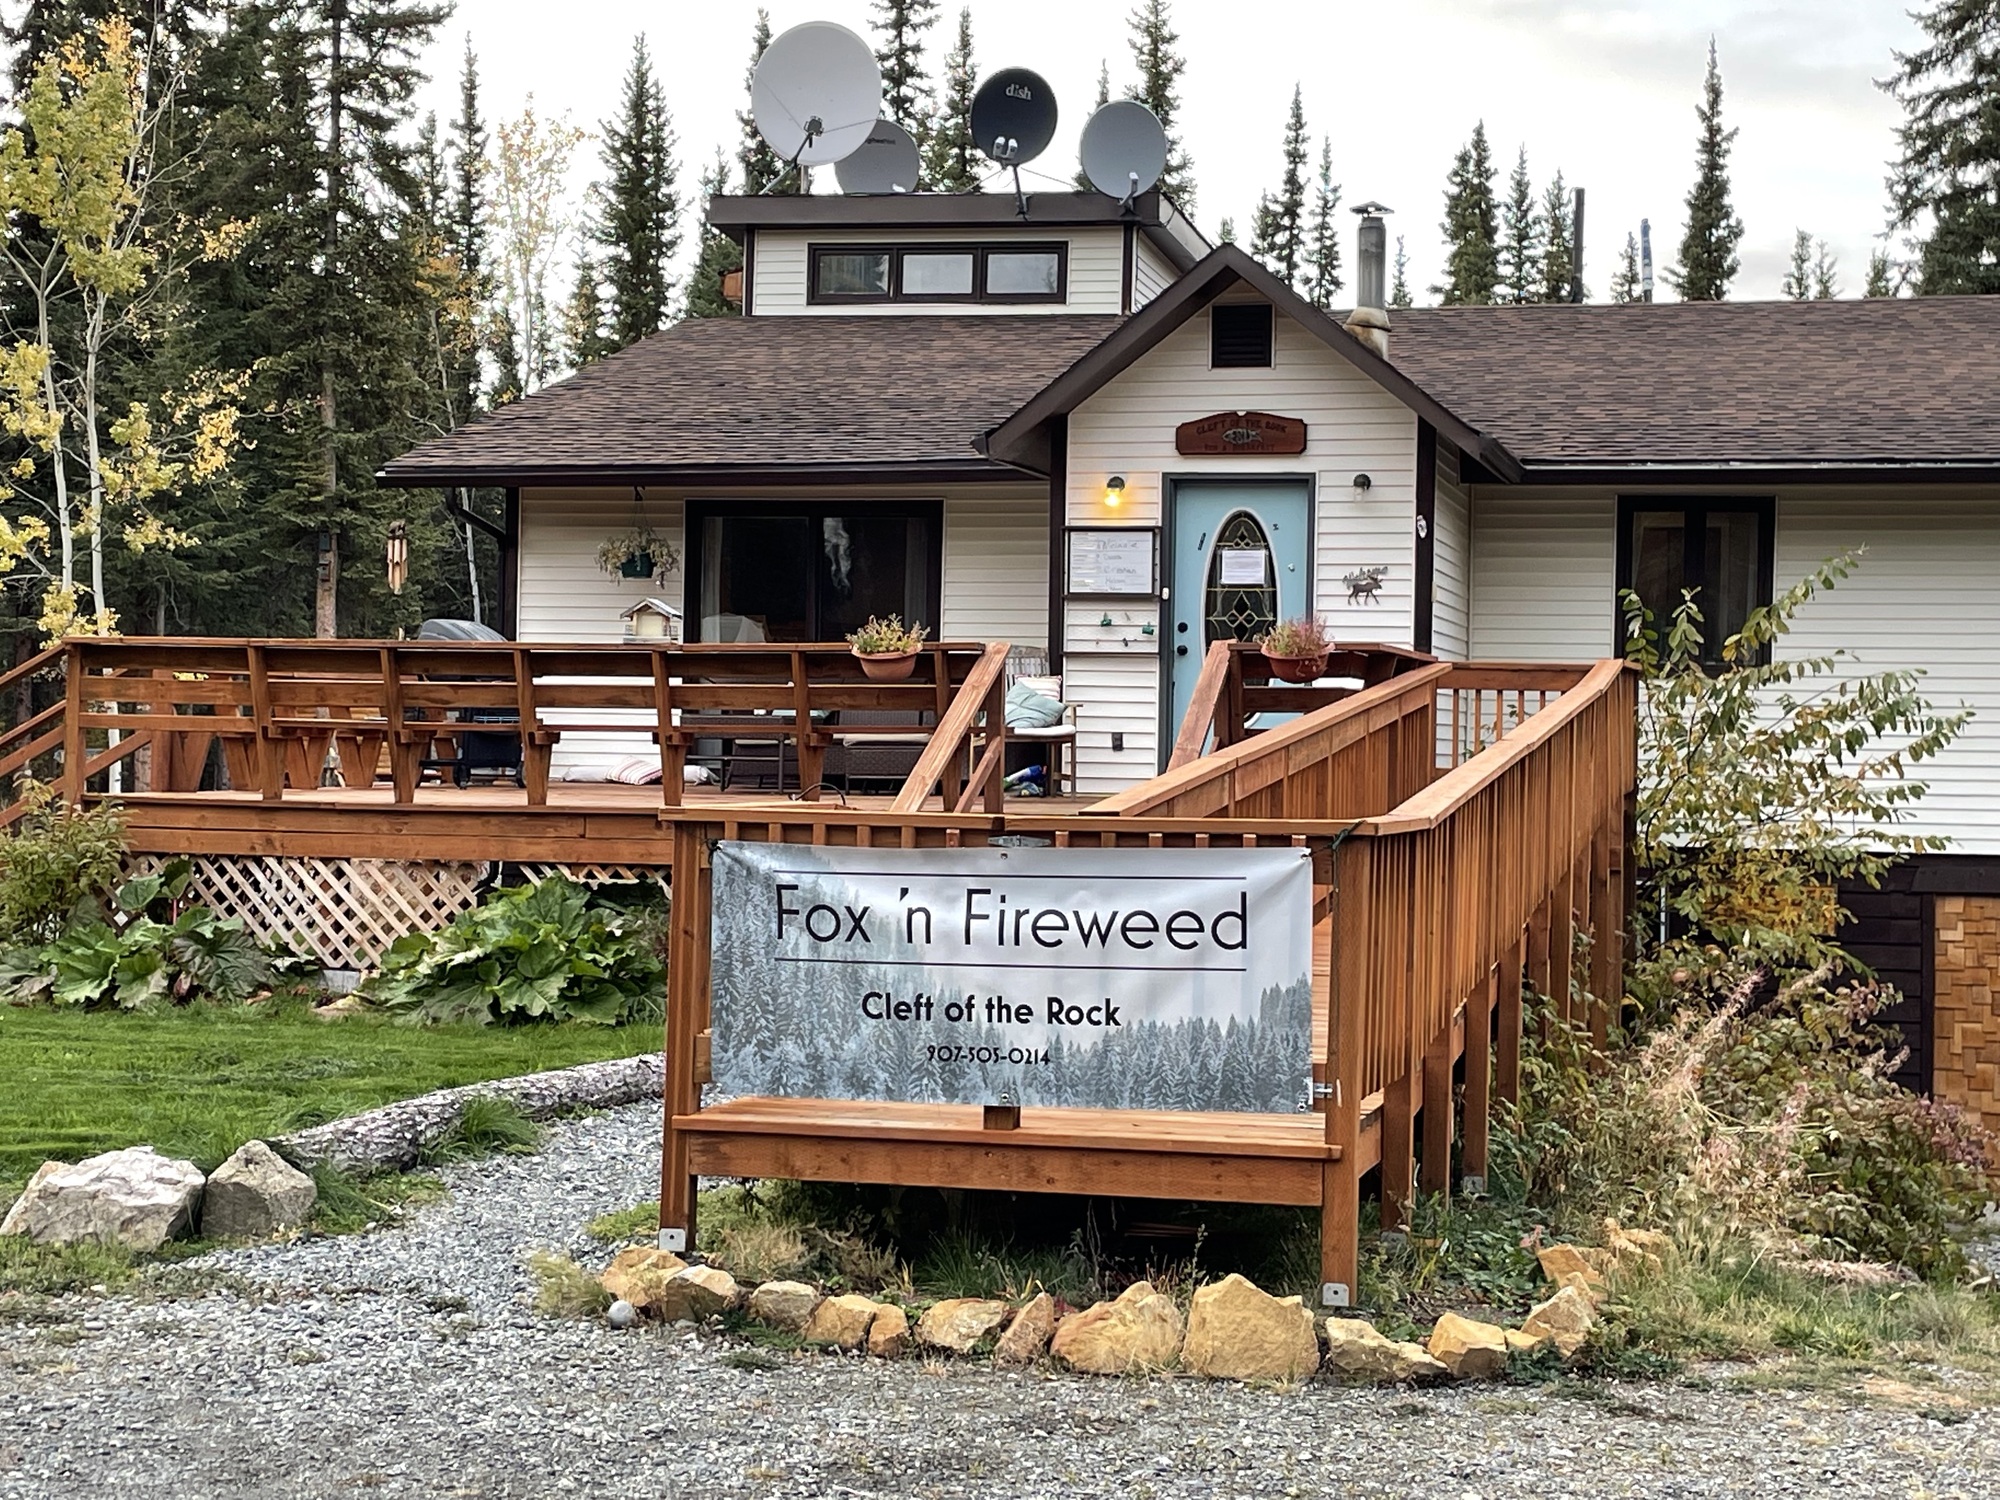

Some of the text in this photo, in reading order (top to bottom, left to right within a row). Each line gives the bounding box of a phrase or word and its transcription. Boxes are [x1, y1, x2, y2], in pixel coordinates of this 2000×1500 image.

[1005, 83, 1032, 100] dish
[776, 884, 872, 943] Fox
[964, 888, 1248, 950] Fireweed
[861, 991, 1122, 1027] Cleft of the Rock
[927, 1045, 1051, 1066] 907-505-0214
